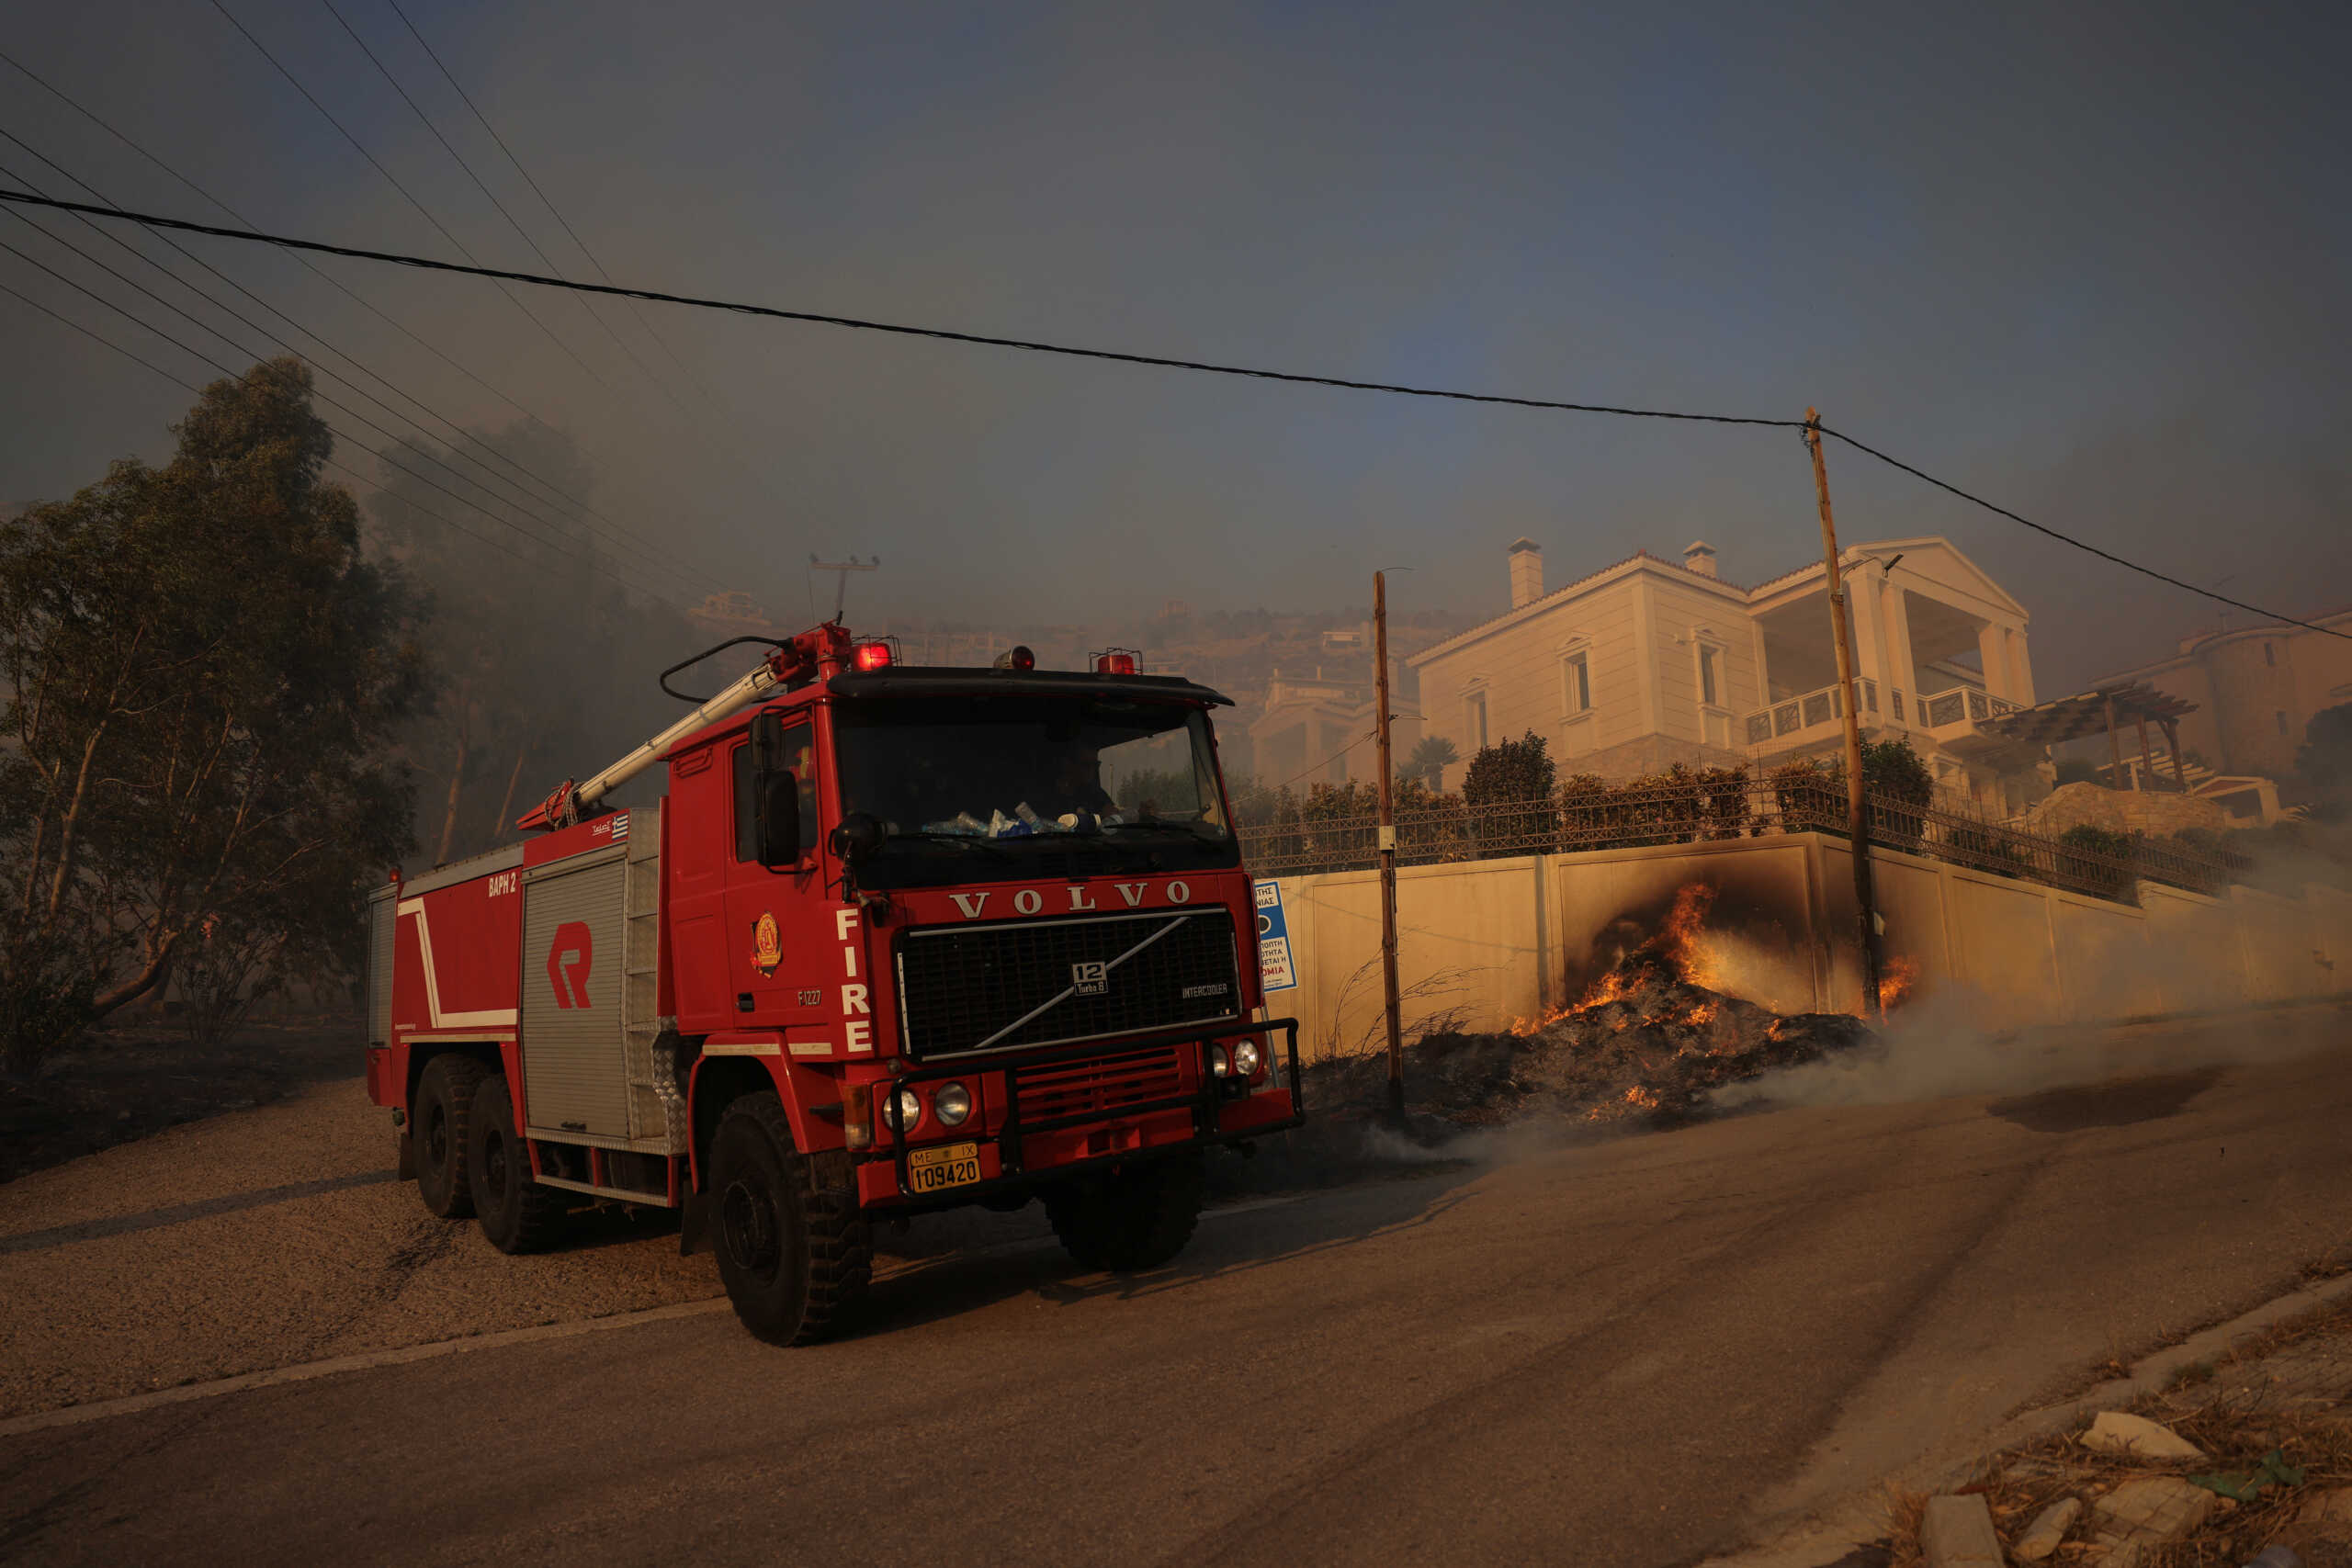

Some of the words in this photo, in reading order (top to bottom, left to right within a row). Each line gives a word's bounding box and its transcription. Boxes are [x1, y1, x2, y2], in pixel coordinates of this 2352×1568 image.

[511, 872, 516, 894] 2
[948, 880, 1190, 919] VOLVO
[835, 908, 873, 1054] FIRE
[1077, 964, 1102, 979] 12
[1078, 983, 1097, 994] Turbo
[1182, 983, 1228, 999] INTERCOOLER
[916, 1161, 977, 1189] 109420
